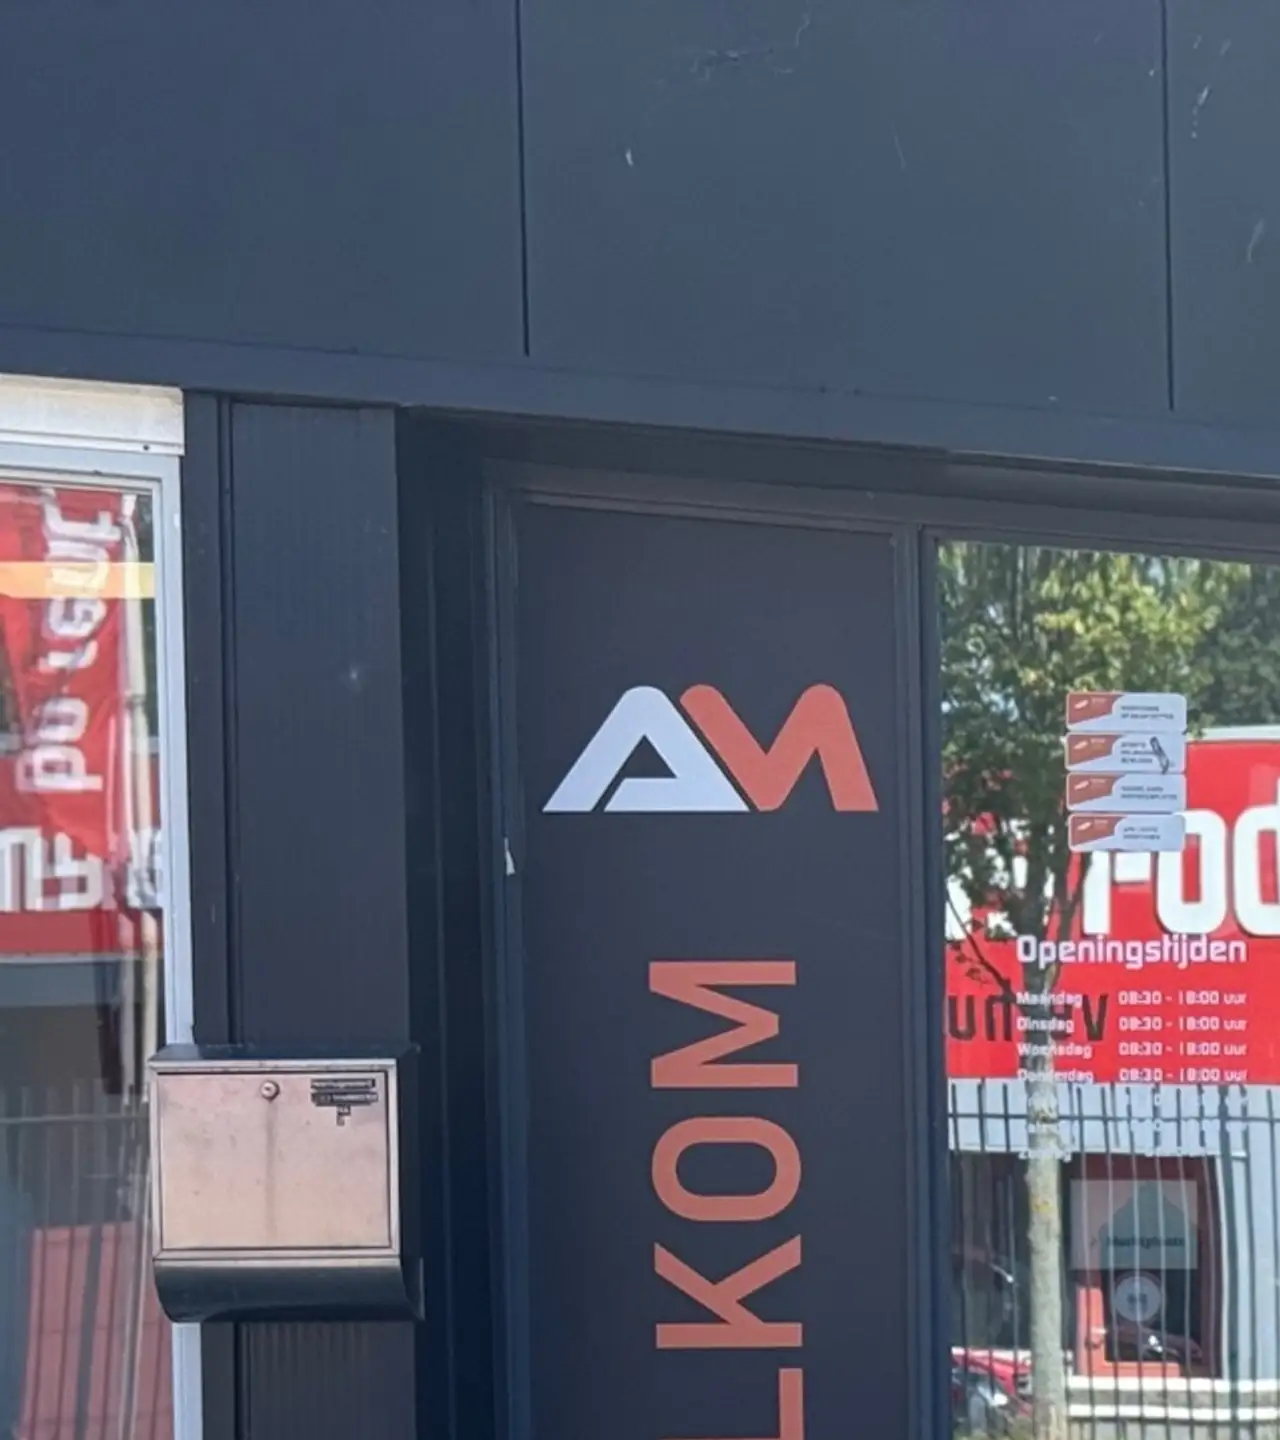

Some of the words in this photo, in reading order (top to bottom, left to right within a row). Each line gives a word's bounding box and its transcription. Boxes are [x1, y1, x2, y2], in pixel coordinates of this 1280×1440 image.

[542, 683, 880, 813] AM
[1015, 934, 1248, 970] Openingstijden
[1015, 990, 1083, 1007] Maandag
[1223, 993, 1248, 1005] uur
[1015, 1016, 1074, 1033] Dinsdag
[1223, 1019, 1248, 1031] uur
[1223, 1045, 1248, 1057] uur
[1223, 1071, 1248, 1083] uur
